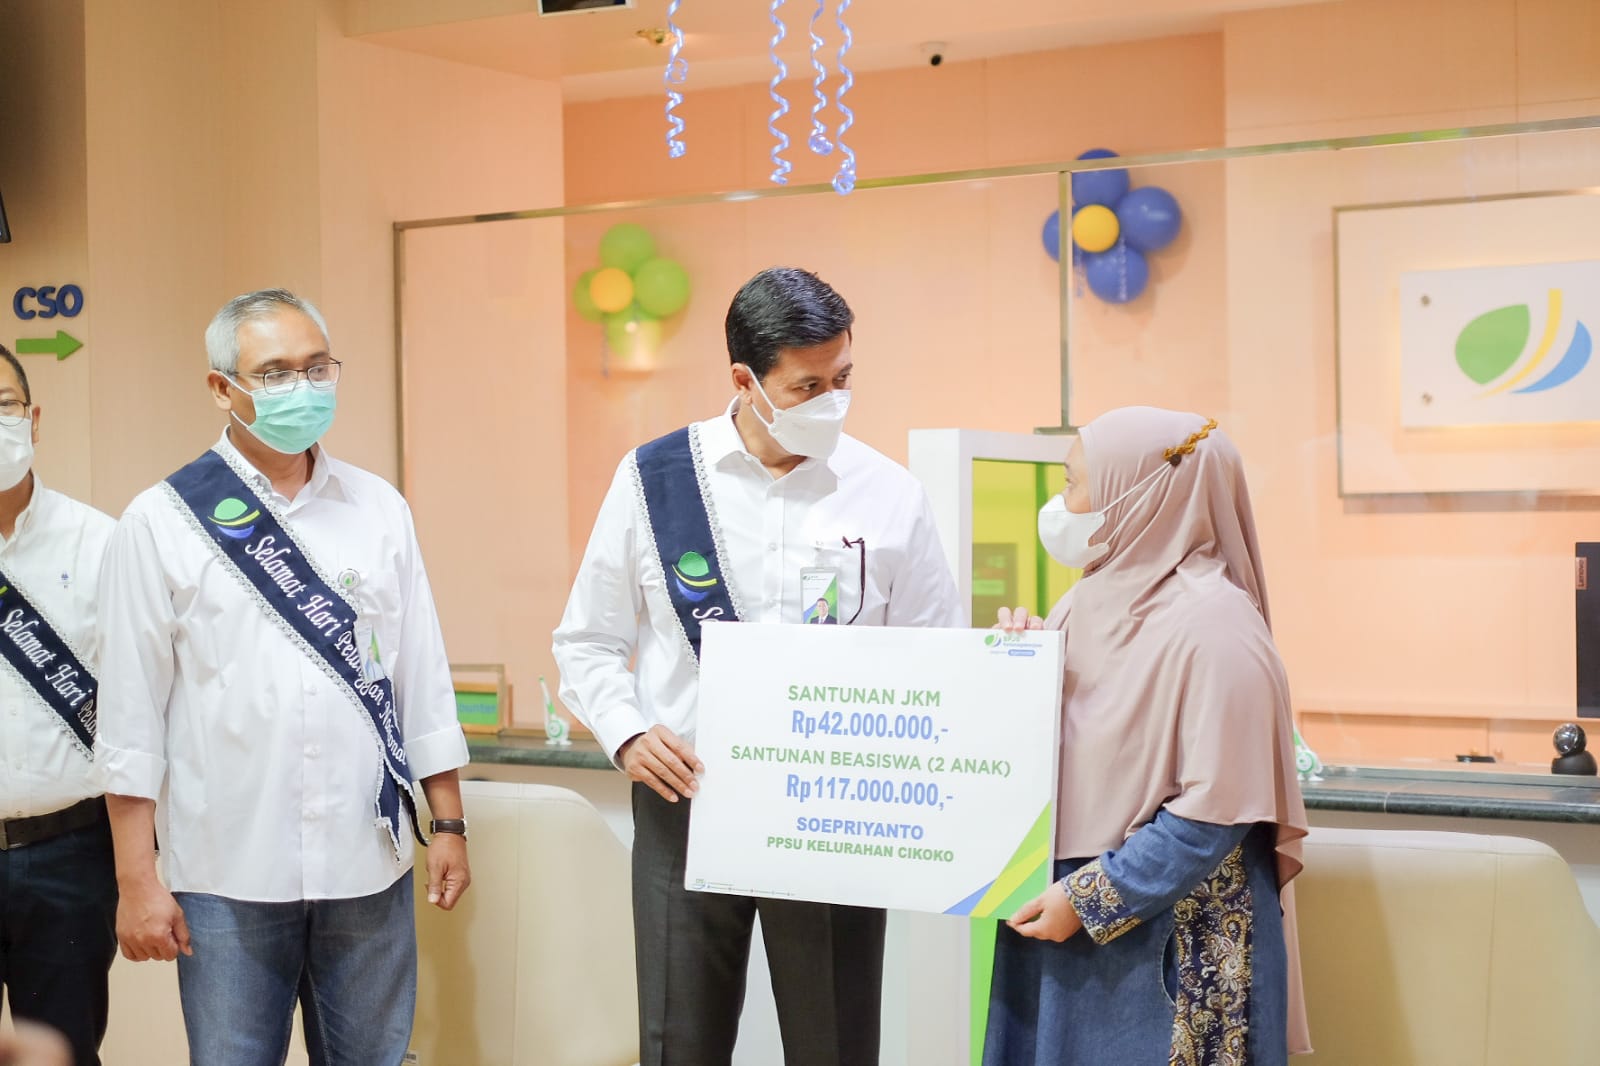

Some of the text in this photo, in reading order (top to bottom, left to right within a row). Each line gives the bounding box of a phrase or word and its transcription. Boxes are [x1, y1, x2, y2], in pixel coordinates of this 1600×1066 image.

[13, 284, 84, 320] CSO
[245, 535, 304, 599] Selamat
[297, 594, 349, 637] Hari
[0, 608, 57, 669] Selamat
[45, 664, 93, 707] Hari
[788, 685, 941, 707] SANTUNAN JKM
[791, 709, 949, 743] Rp42.000.000,-
[730, 745, 1012, 777] SANTUNAN BEASISWA (2 ANAK)
[786, 774, 954, 810] Rp117.000.000,-
[796, 816, 924, 841] SOEPRIYANTO
[767, 836, 954, 863] PPSU KELURAHAN CIKOKO
